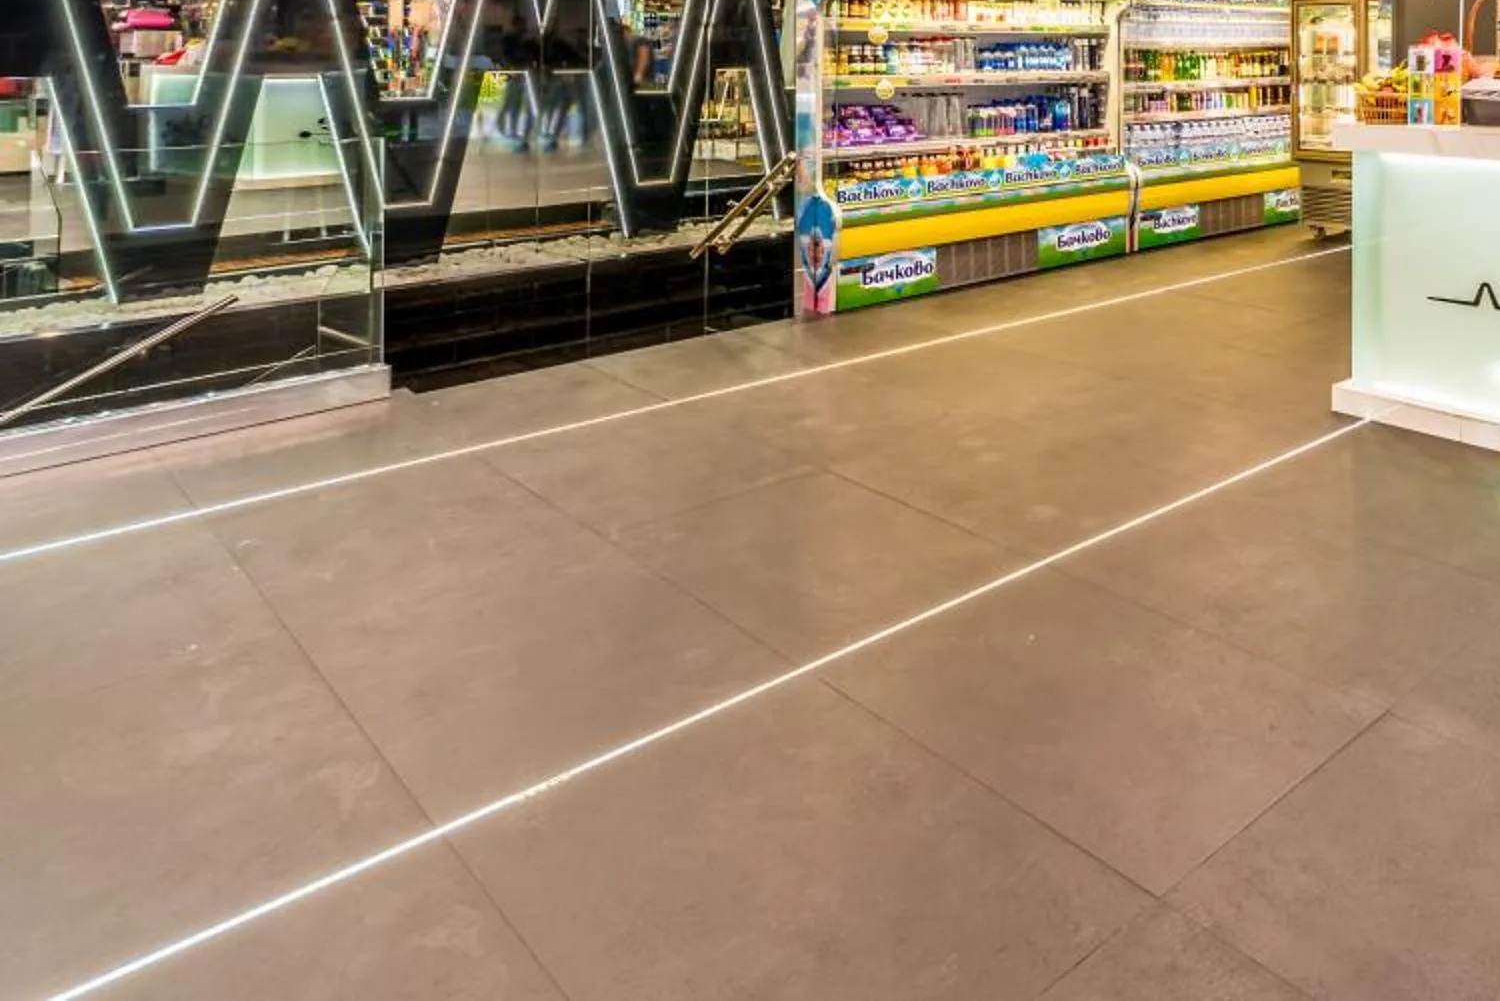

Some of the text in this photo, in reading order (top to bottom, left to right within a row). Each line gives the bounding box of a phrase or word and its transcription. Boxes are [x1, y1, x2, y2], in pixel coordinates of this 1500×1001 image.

[837, 186, 905, 203] Bachkovo
[927, 178, 985, 194] Bachkovo
[1005, 168, 1057, 184] Bachkovo
[1057, 227, 1112, 249] Бачково
[861, 260, 935, 286] Бачково
